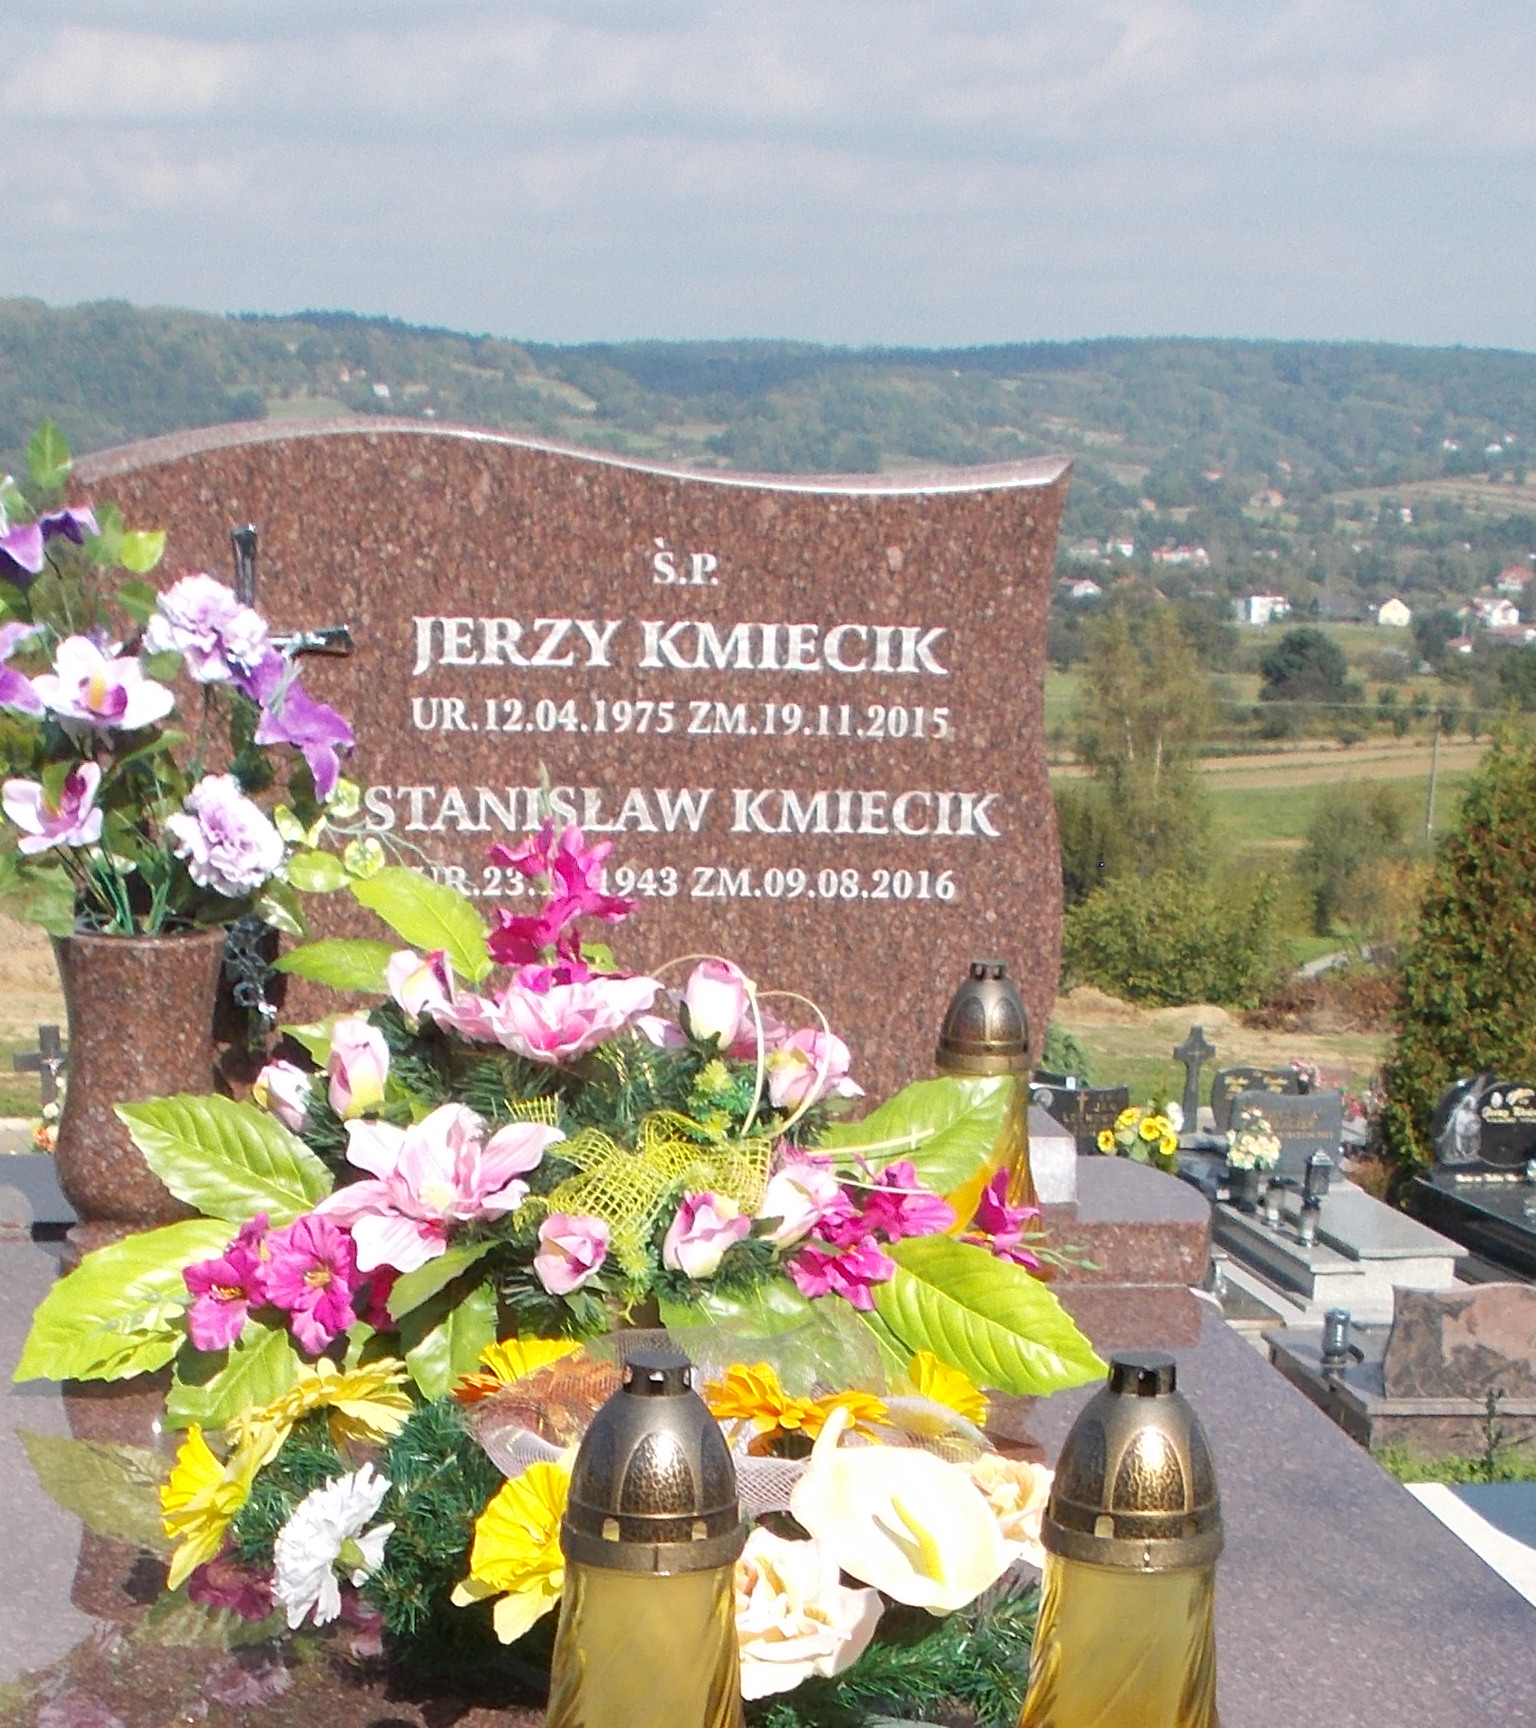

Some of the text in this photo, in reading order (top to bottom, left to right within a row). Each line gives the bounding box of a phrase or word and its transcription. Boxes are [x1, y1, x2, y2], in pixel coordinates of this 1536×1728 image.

[652, 536, 719, 586] Ś.P.
[412, 616, 948, 676] JERZY KMIECIK
[411, 697, 950, 739] UR.12.04.1975 ZM.19.11.2015
[364, 784, 1002, 838] STANISŁAW KMIECIK
[411, 864, 957, 903] R.23.1943 ZM.09.08.2016
